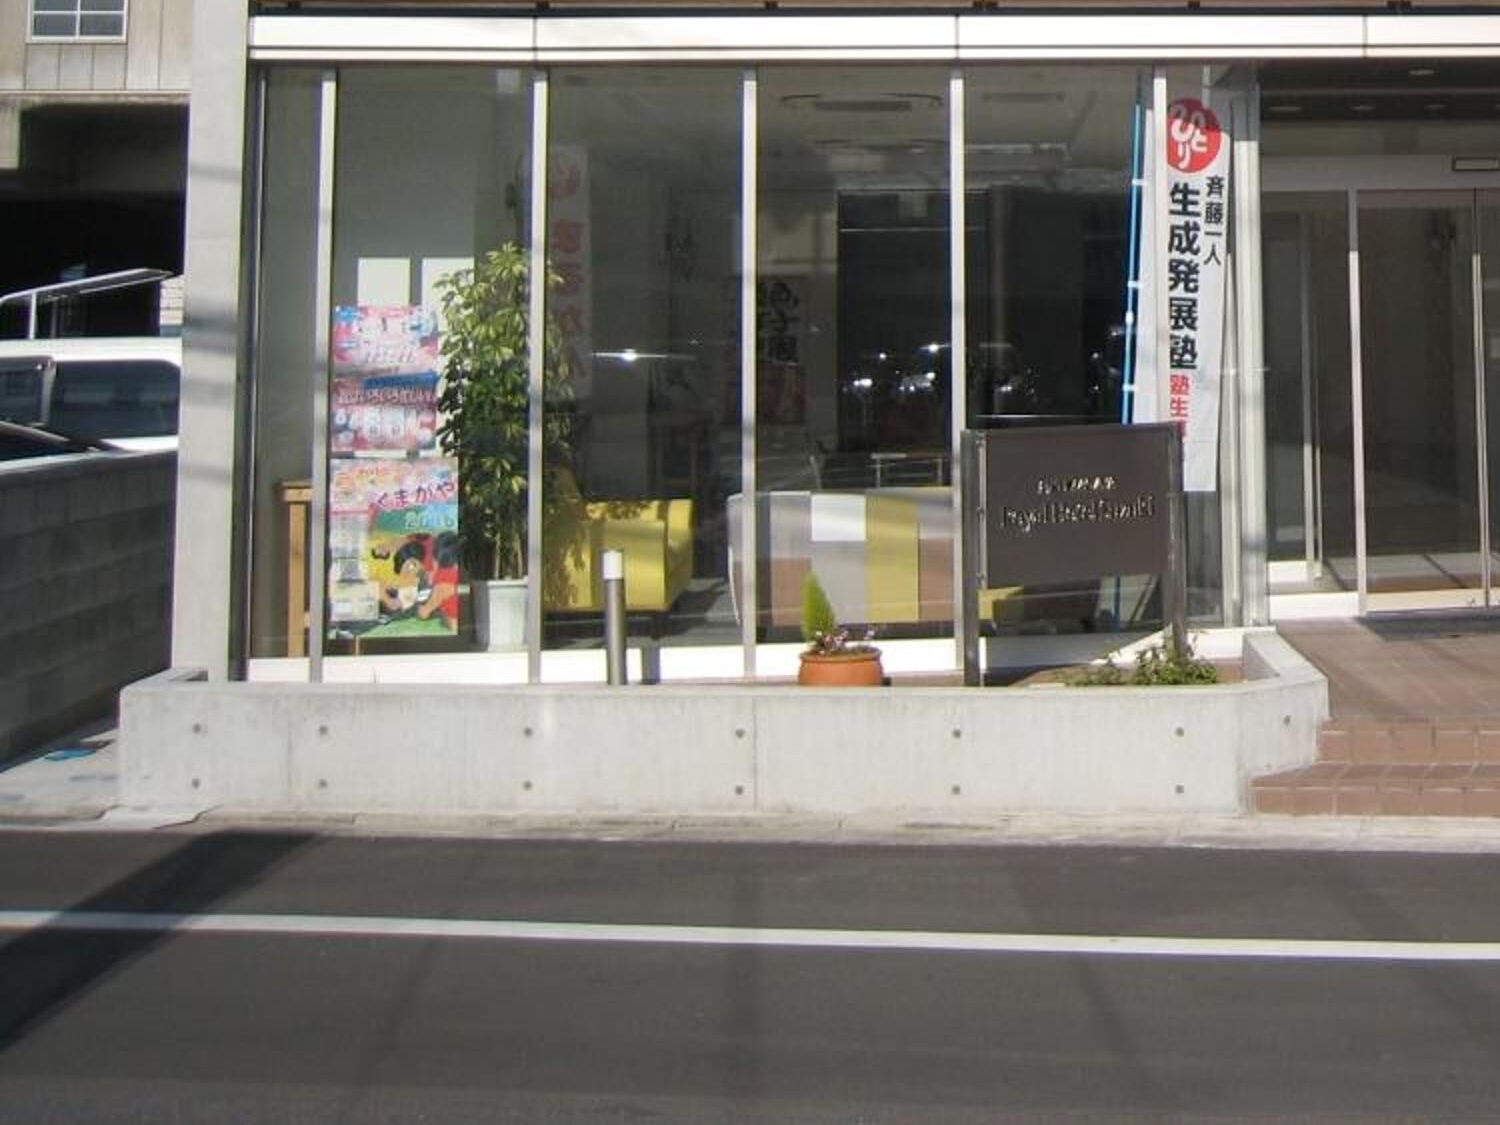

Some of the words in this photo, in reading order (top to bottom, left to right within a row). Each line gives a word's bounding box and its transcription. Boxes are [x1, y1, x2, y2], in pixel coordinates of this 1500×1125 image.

[1168, 182, 1201, 369] 生成発展塾
